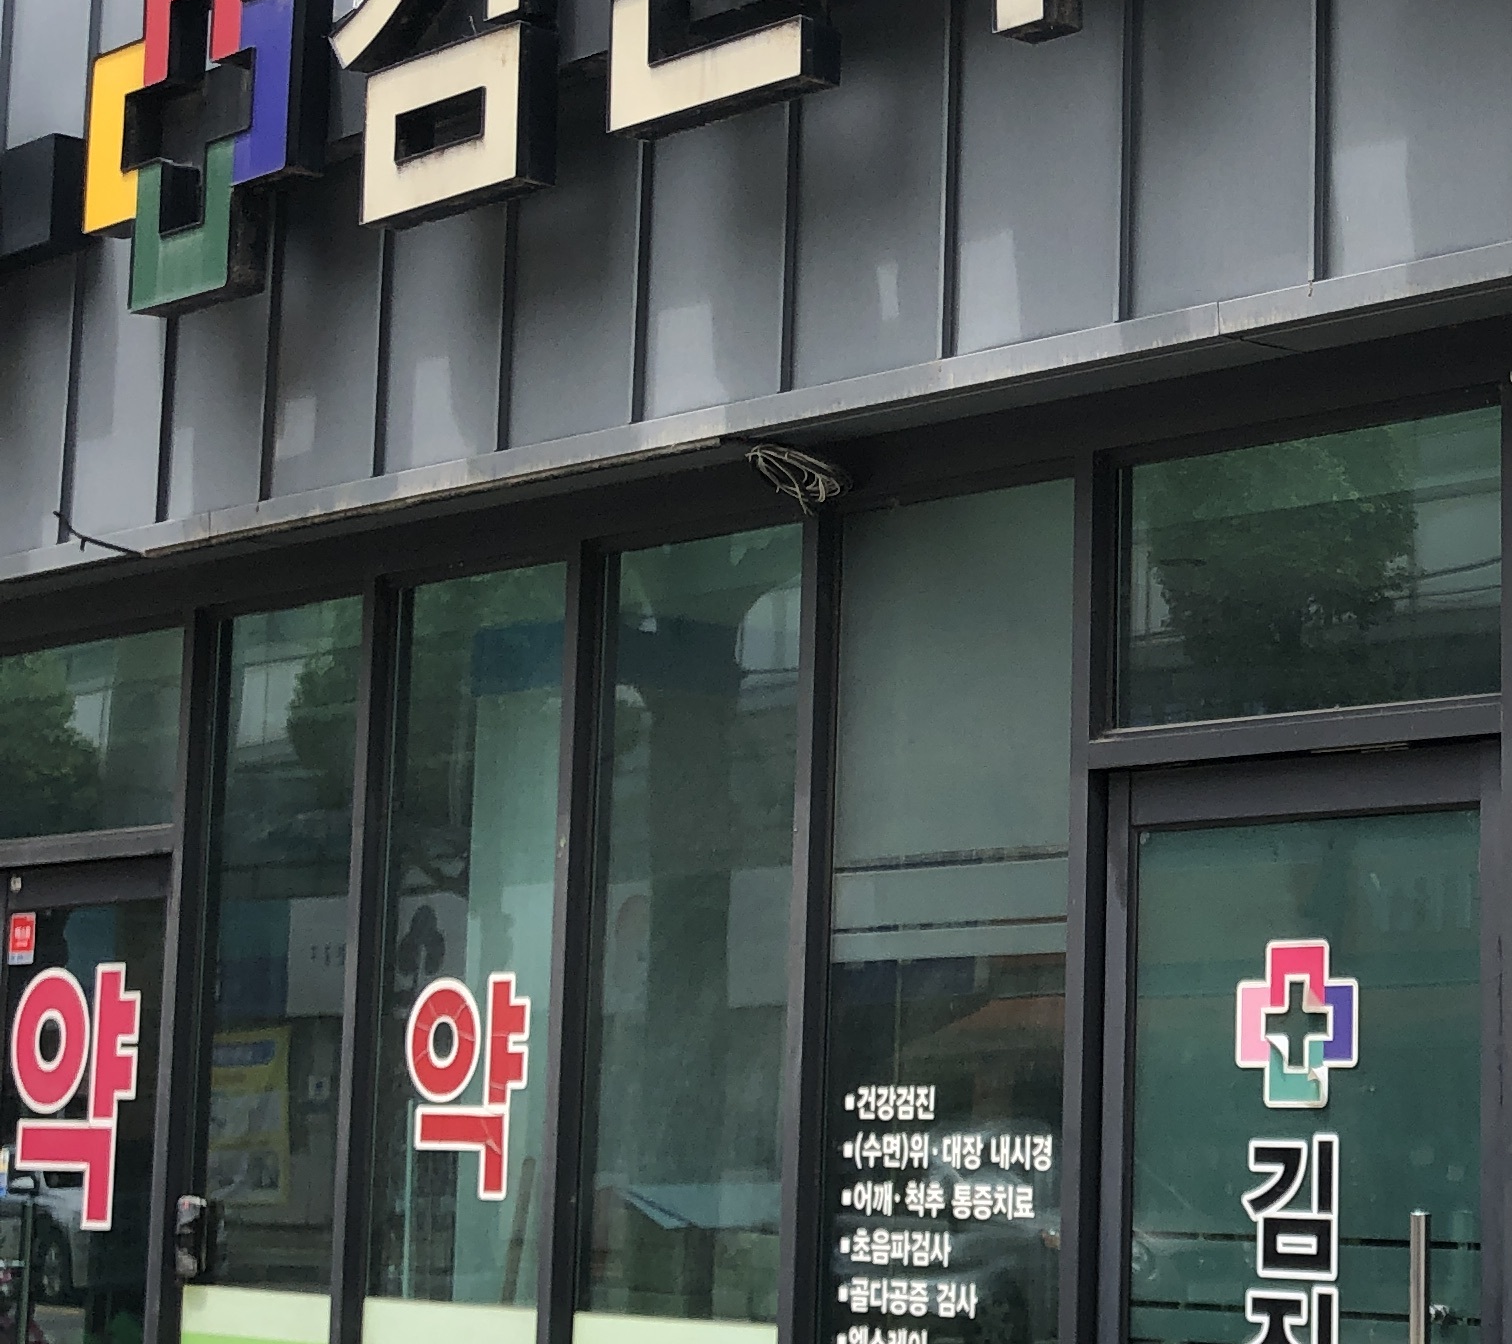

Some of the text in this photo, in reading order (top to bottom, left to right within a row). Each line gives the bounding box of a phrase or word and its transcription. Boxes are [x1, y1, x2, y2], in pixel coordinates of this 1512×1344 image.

[11, 962, 141, 1231] 약
[406, 971, 531, 1201] 약
[857, 1085, 937, 1121] 건강검진
[990, 1133, 1053, 1172] 내시경
[951, 1183, 1036, 1221] 통증치료
[850, 1227, 953, 1268] 초음파검사
[850, 1276, 979, 1320] 골다공증 검사
